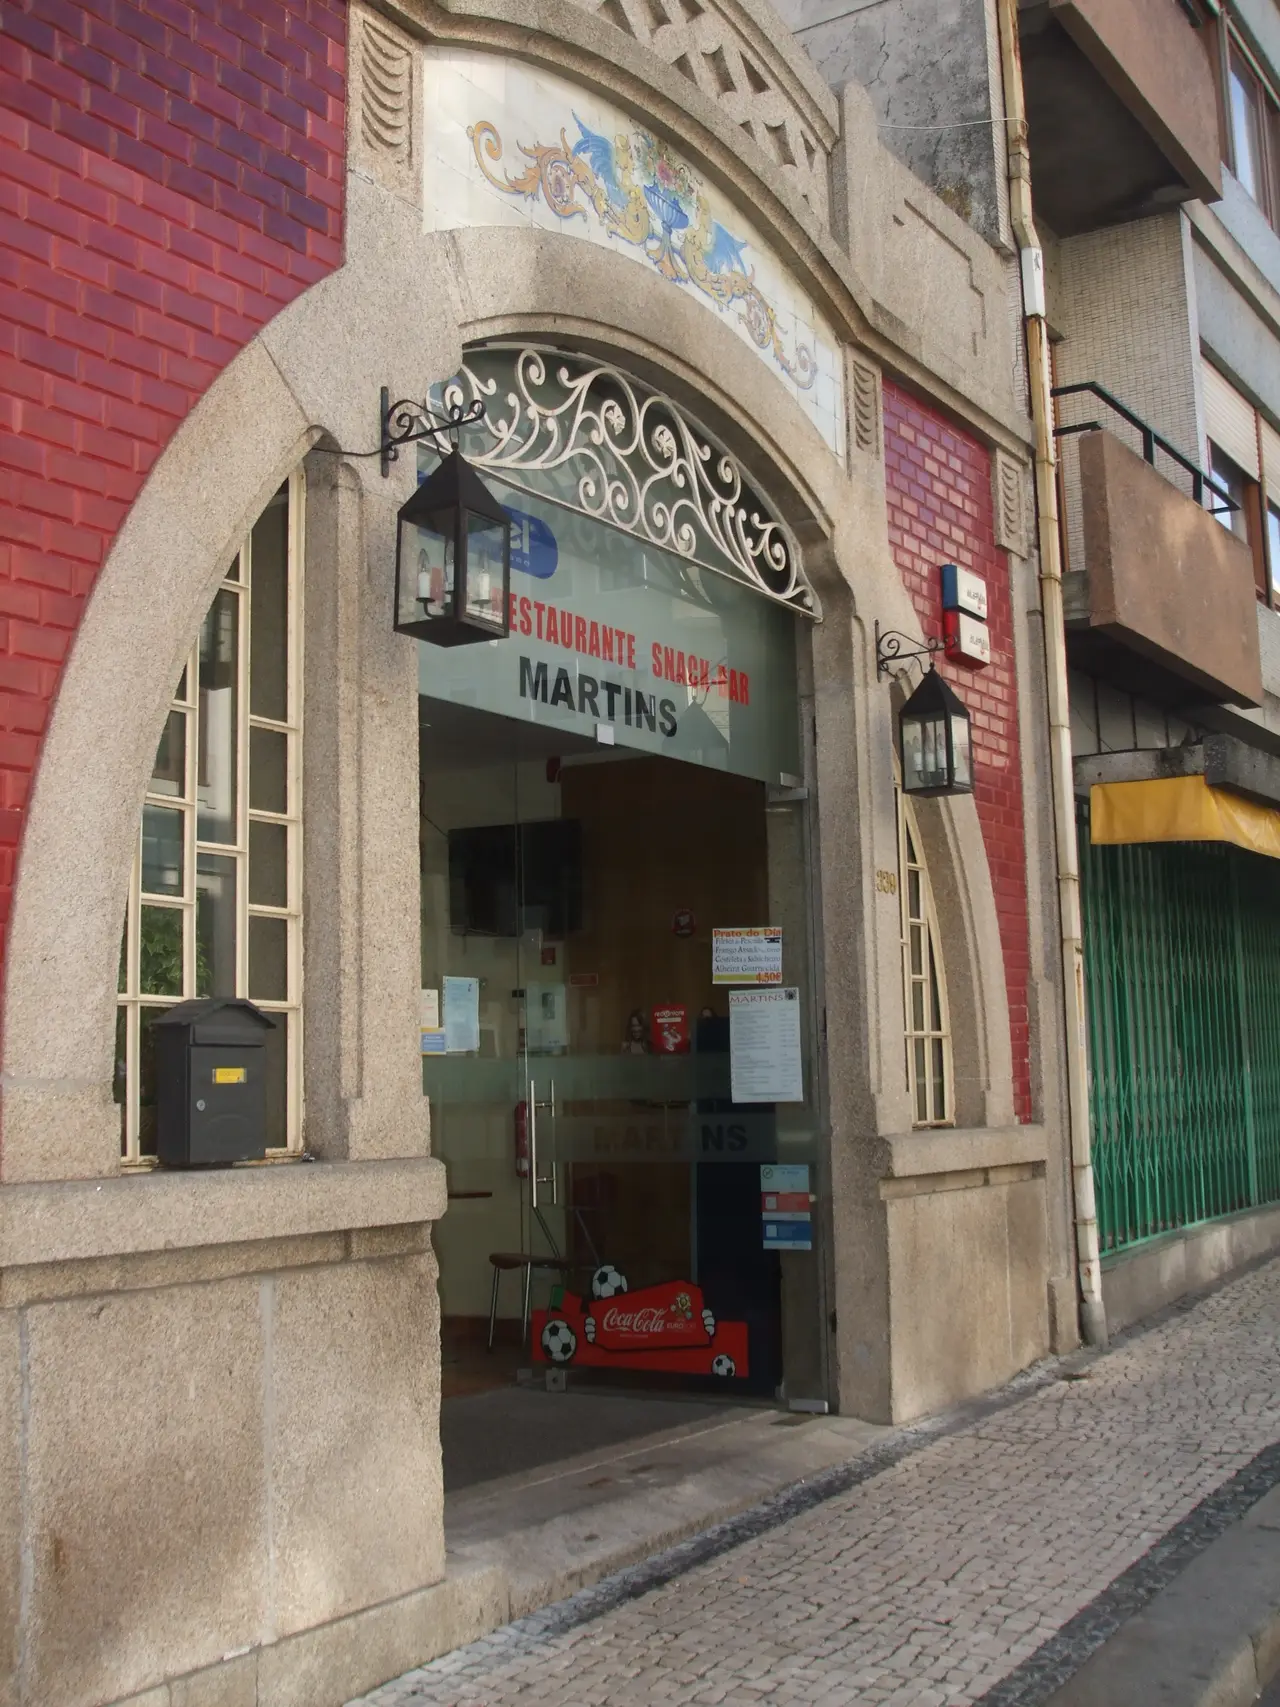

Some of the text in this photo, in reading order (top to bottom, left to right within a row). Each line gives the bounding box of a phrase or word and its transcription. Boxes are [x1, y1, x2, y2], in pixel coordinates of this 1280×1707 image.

[652, 641, 710, 693] SNACK
[718, 664, 750, 706] BAR
[519, 655, 678, 738] MARTINS
[713, 928, 781, 938] Prato do Dia
[730, 995, 784, 1003] MARTINS
[594, 1124, 748, 1152] MARTNS
[603, 1307, 669, 1333] Coca-Cola
